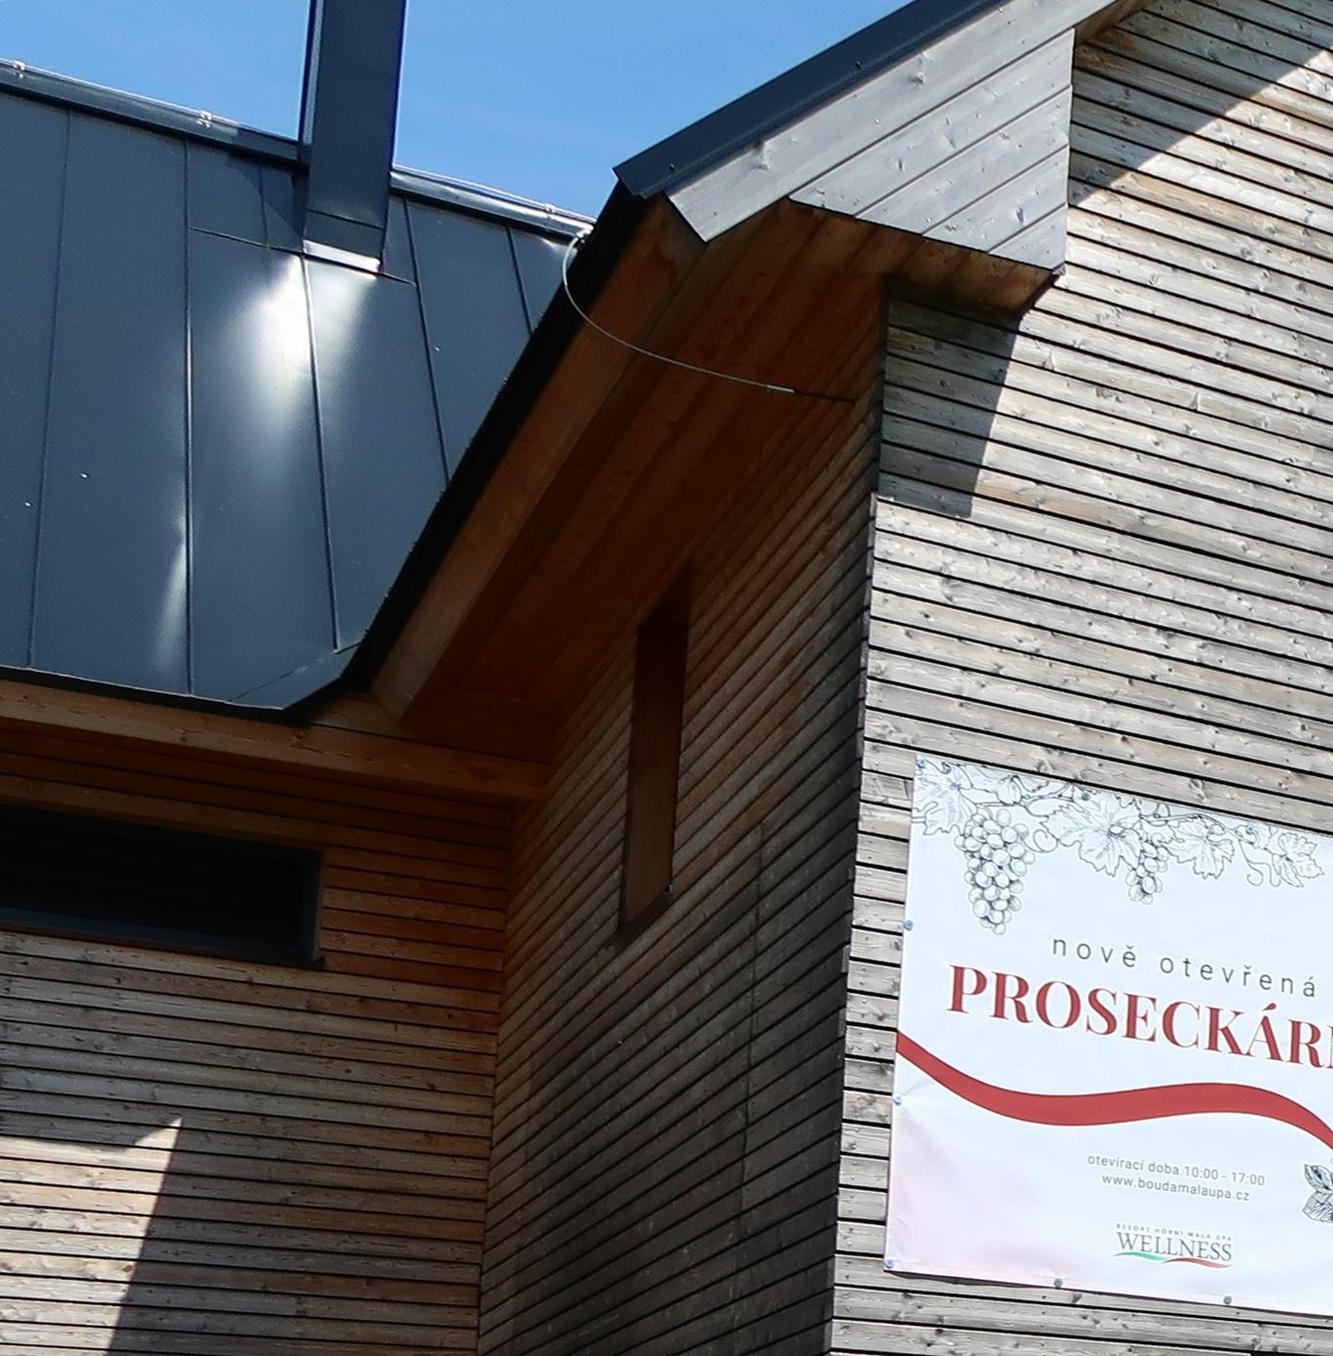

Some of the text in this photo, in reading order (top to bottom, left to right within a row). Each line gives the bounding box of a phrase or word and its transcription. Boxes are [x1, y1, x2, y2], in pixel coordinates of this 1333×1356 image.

[1052, 937, 1317, 997] nově otevřená
[1102, 1174, 1250, 1201] www.boudamalaupa.cz
[1147, 1161, 1179, 1176] doba
[1184, 1166, 1219, 1181] 10:00
[1231, 1171, 1265, 1186] 17:00
[1116, 1231, 1232, 1261] WELLNESS
